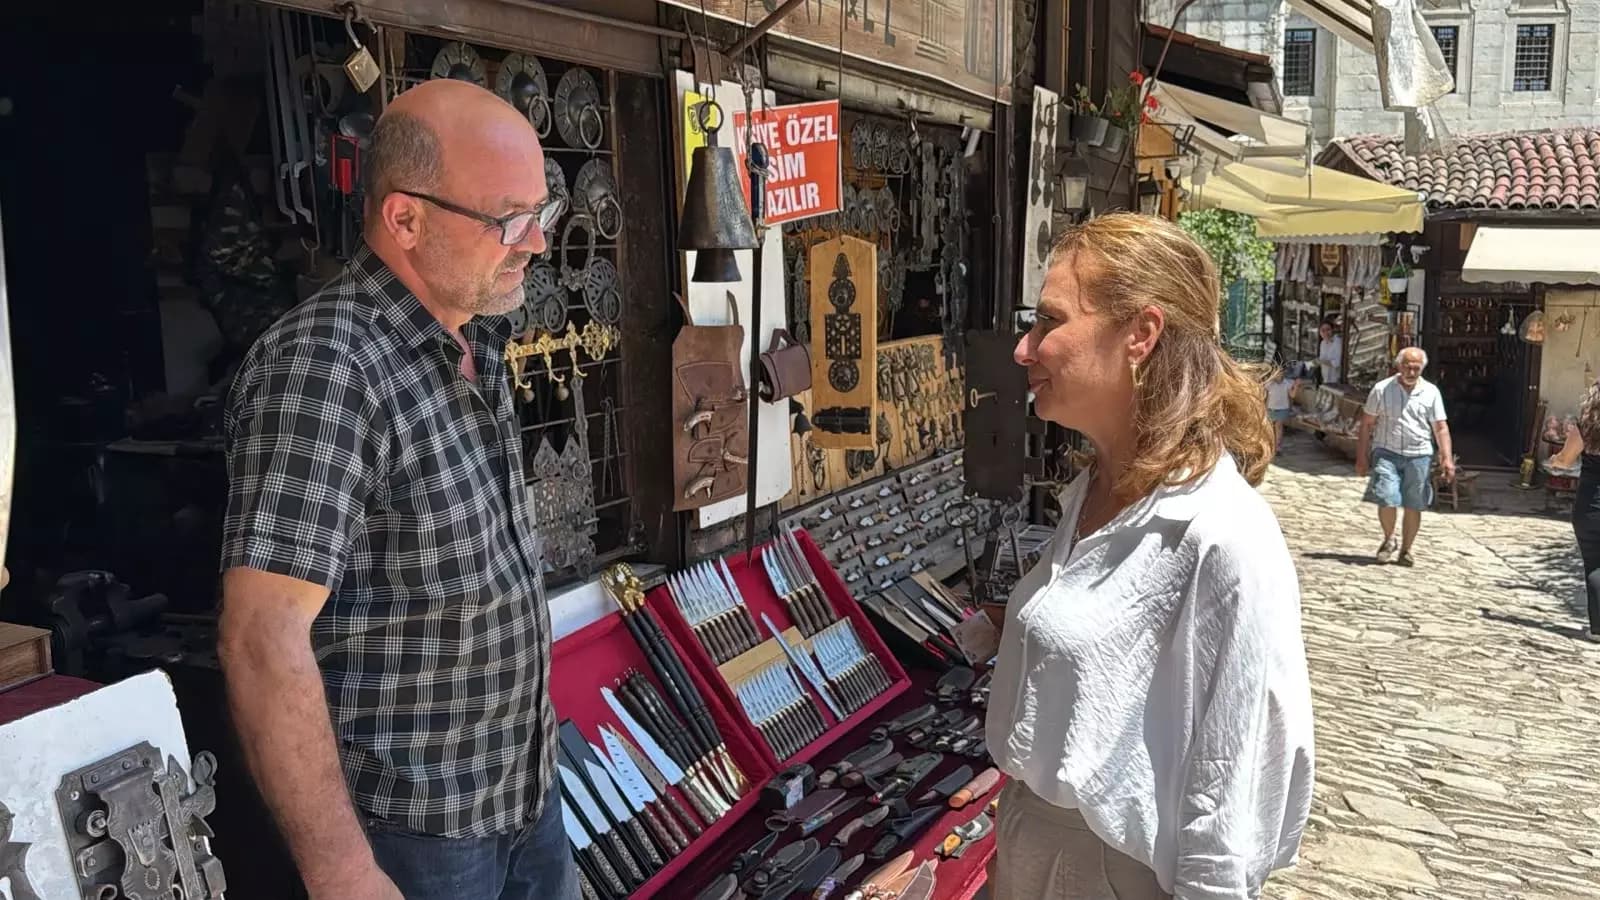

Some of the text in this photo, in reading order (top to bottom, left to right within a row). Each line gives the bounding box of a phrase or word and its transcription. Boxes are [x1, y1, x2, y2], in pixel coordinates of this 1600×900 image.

[786, 114, 837, 146] ÖZEL
[767, 149, 806, 183] SİM
[767, 182, 820, 217] AZILIR
